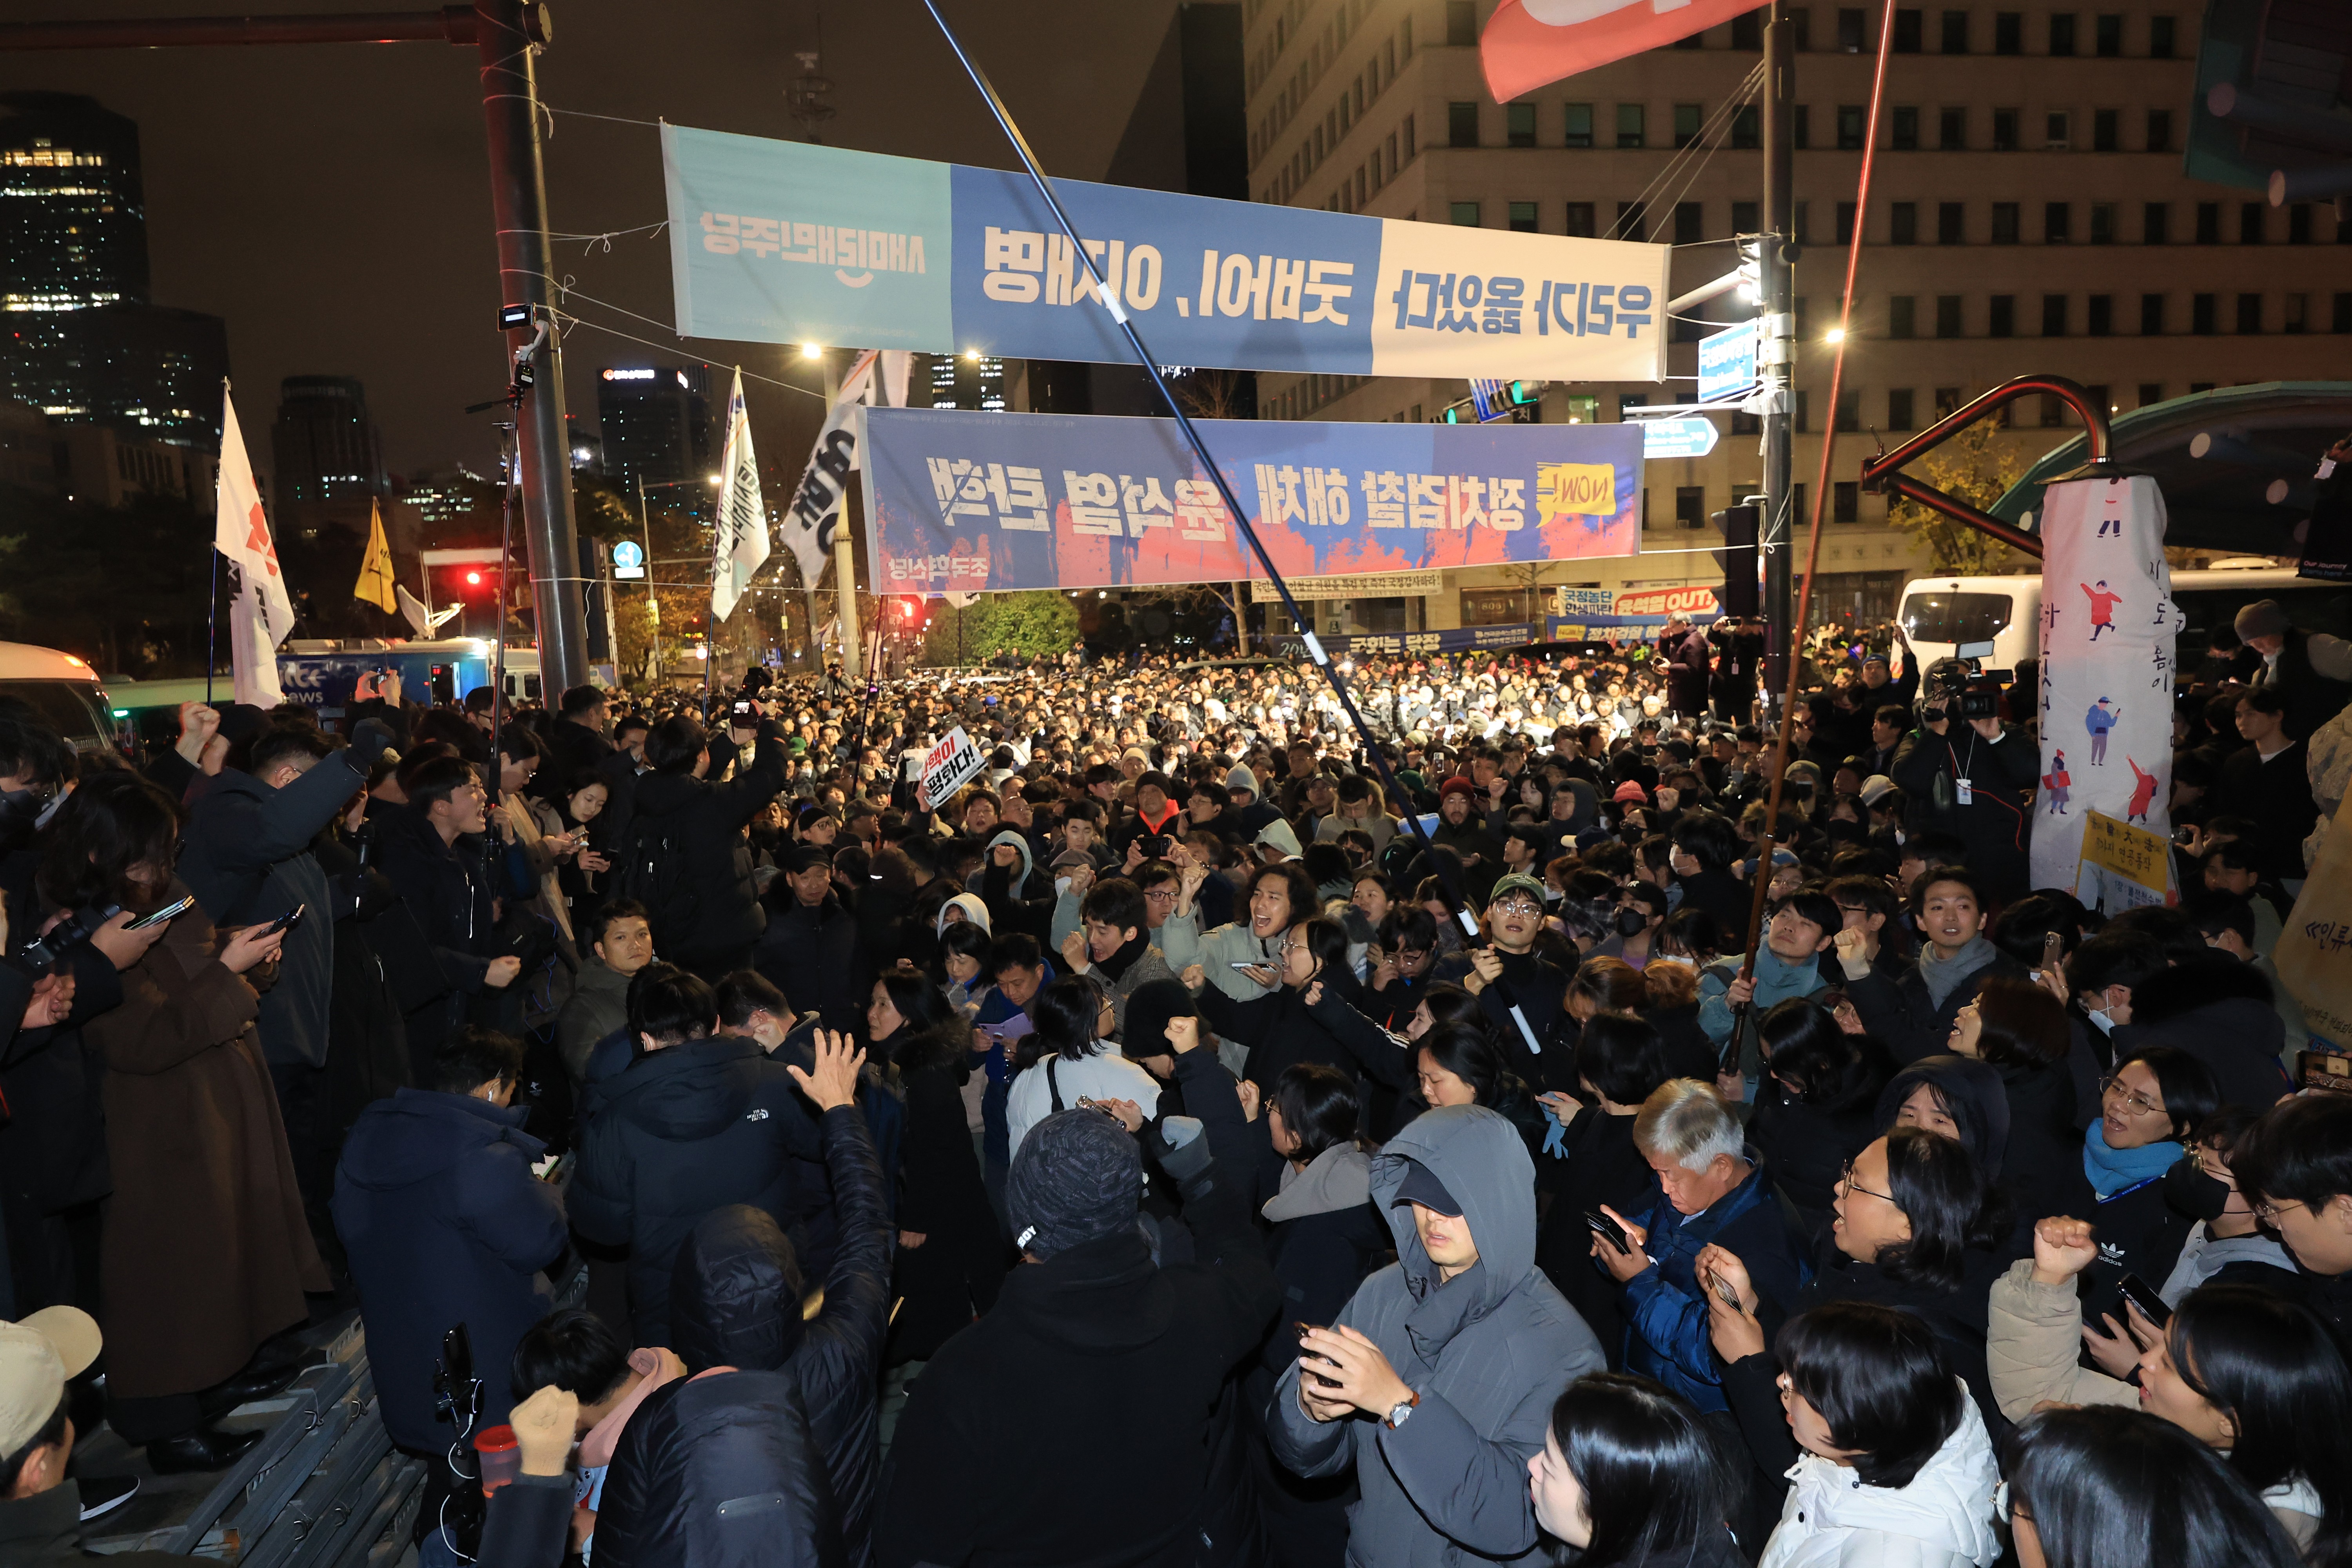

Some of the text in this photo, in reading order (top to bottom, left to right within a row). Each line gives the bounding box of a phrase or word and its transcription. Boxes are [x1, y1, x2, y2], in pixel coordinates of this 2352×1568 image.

[1254, 580, 1285, 592] 국민의
[1564, 588, 1713, 616] 국정농단 윤석열 OUT!
[1588, 626, 1661, 641] 정치검찰 해
[1350, 633, 1441, 654] 국회는 당장
[927, 744, 976, 797] 평화다!
[2098, 1254, 2123, 1267] adidas
